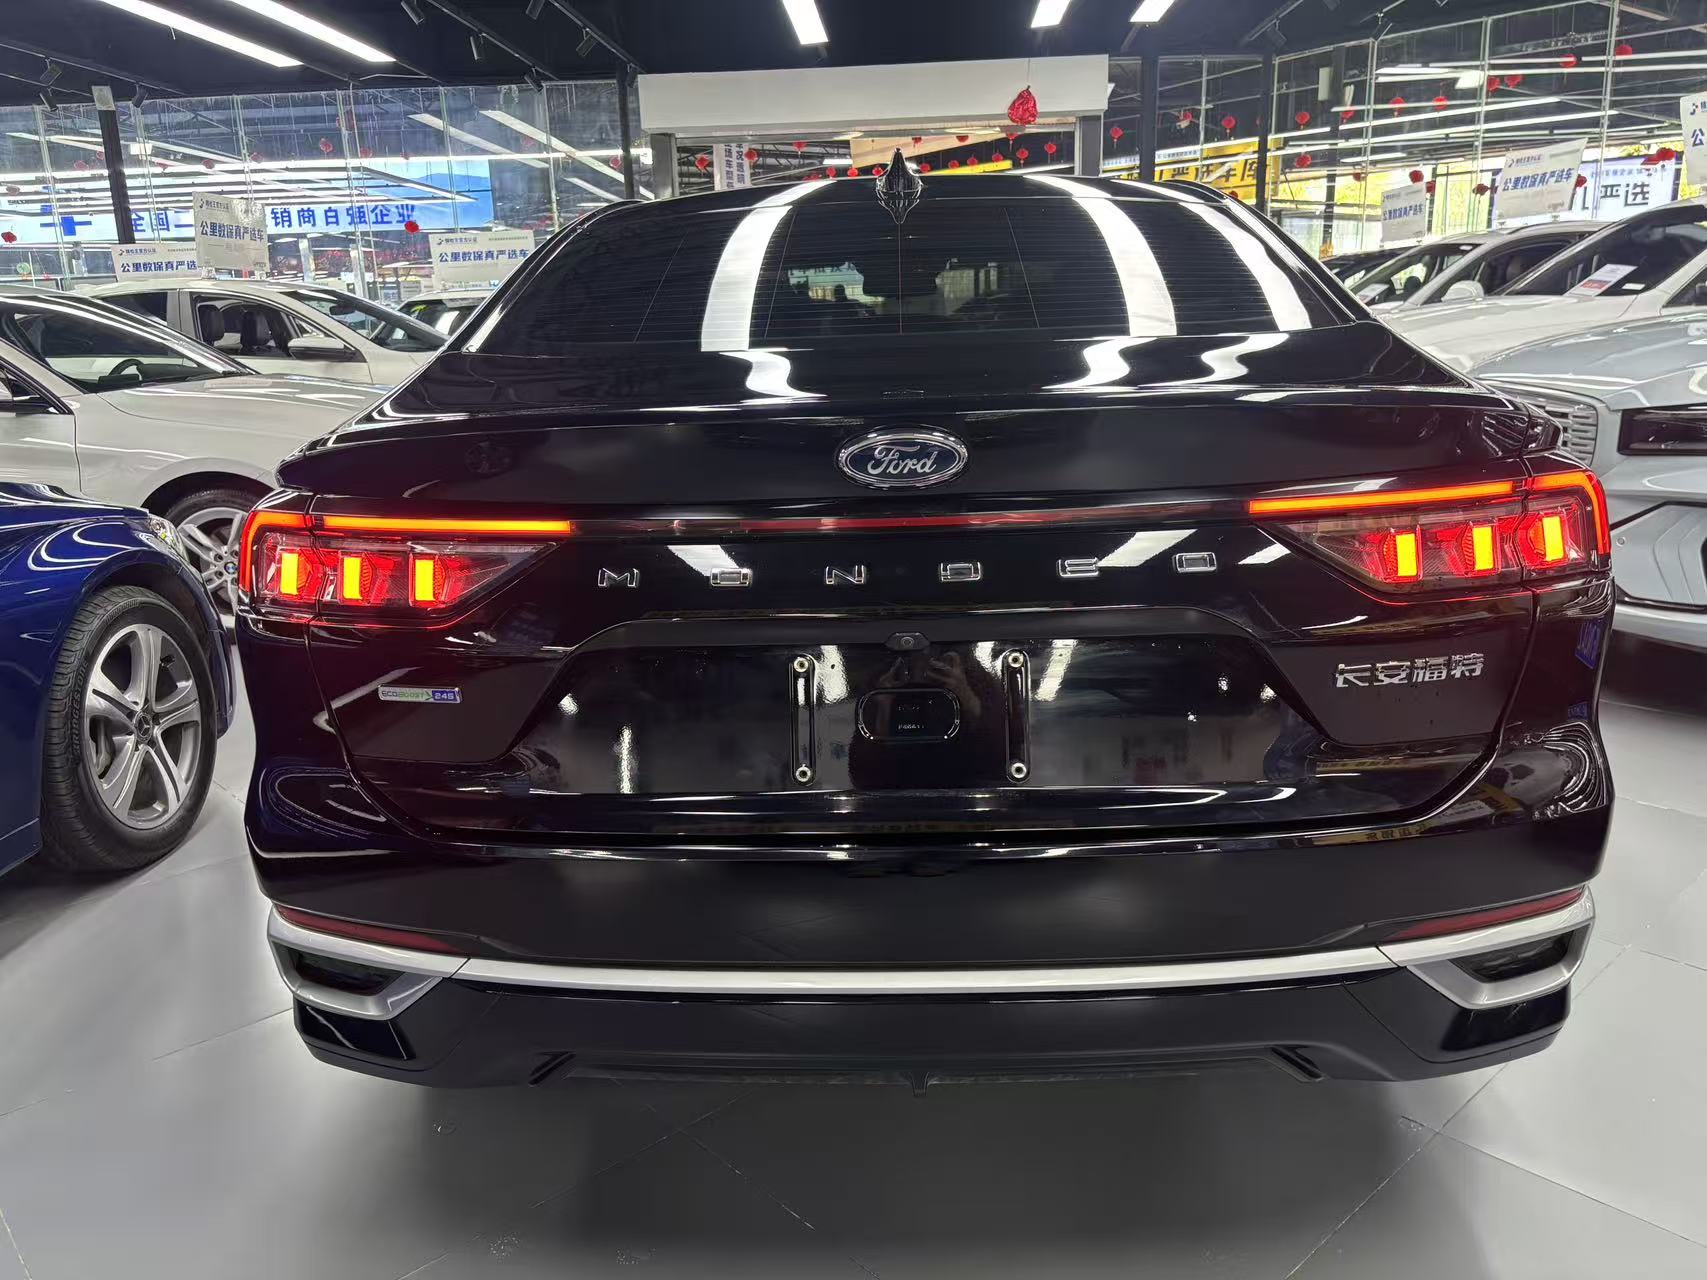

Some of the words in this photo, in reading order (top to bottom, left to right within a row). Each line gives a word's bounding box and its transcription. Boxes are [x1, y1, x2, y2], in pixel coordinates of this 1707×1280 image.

[1503, 168, 1574, 191] 公里数保真严选车
[200, 220, 265, 242] 公里数保真严选车
[439, 248, 530, 263] 公里数保真严选车
[867, 445, 938, 475] Ford
[597, 552, 1217, 588] MONDEO
[1335, 653, 1484, 688] 长安福特
